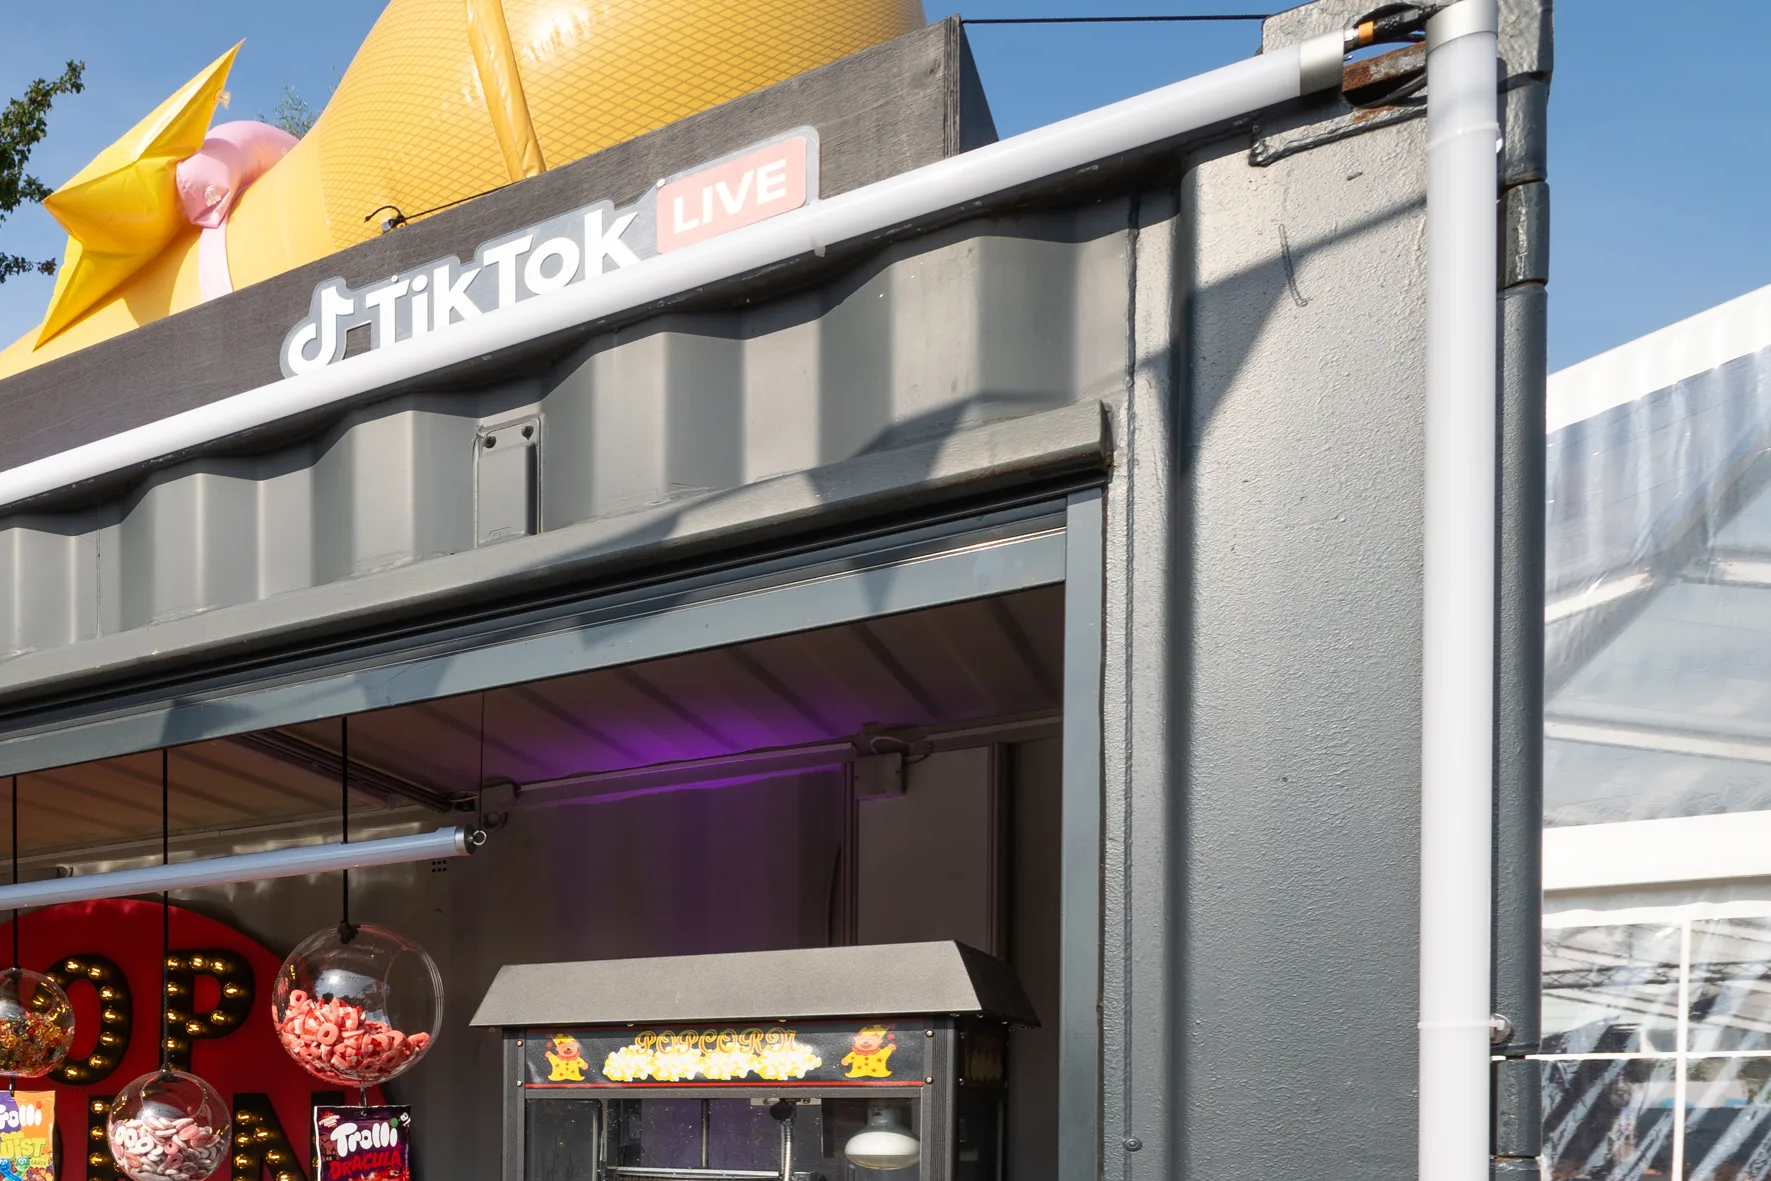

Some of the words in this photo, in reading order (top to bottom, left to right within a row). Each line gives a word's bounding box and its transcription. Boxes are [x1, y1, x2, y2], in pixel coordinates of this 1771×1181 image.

[365, 208, 642, 350] TikTok
[673, 159, 788, 235] LIVE
[635, 1027, 797, 1055] POPCORN
[331, 1118, 398, 1157] Trolli
[329, 1149, 402, 1180] DRACULA
